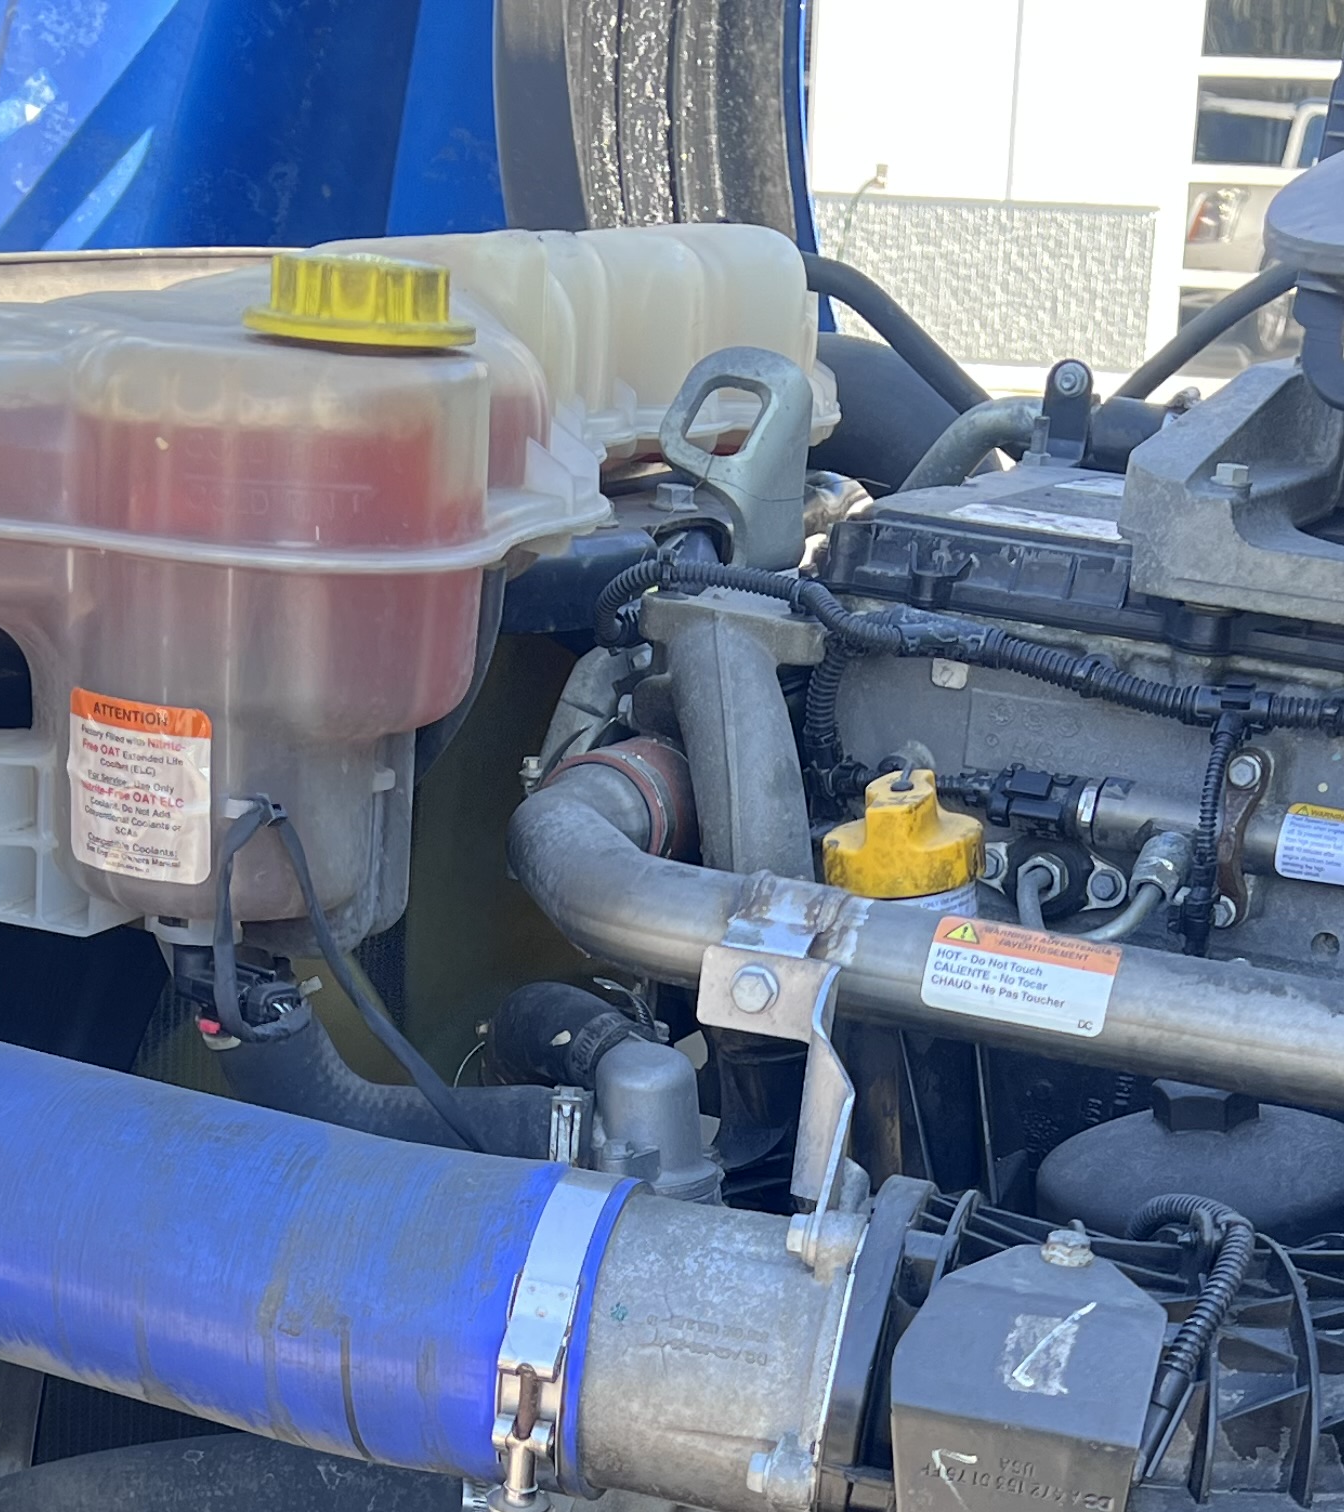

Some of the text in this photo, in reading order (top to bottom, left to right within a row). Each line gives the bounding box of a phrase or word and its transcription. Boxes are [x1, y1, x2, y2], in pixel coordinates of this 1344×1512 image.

[94, 702, 167, 726] ATTENTION
[83, 738, 98, 753] Free
[100, 746, 120, 757] OAT
[167, 756, 184, 766] Life
[154, 783, 174, 795] Only
[133, 792, 156, 803] OAT
[160, 797, 184, 808] ELC
[122, 804, 133, 813] Do
[135, 807, 149, 816] Not
[984, 925, 1029, 942] WARNING
[936, 949, 1043, 977] HOT Do Not Touch
[934, 962, 1048, 991] CALIENTE No Tocar
[931, 974, 1065, 1008] CHAUD Ne Pas Toucher
[1078, 1020, 1093, 1030] DC
[1000, 1458, 1035, 1477] USA
[996, 1474, 1025, 1494] 153
